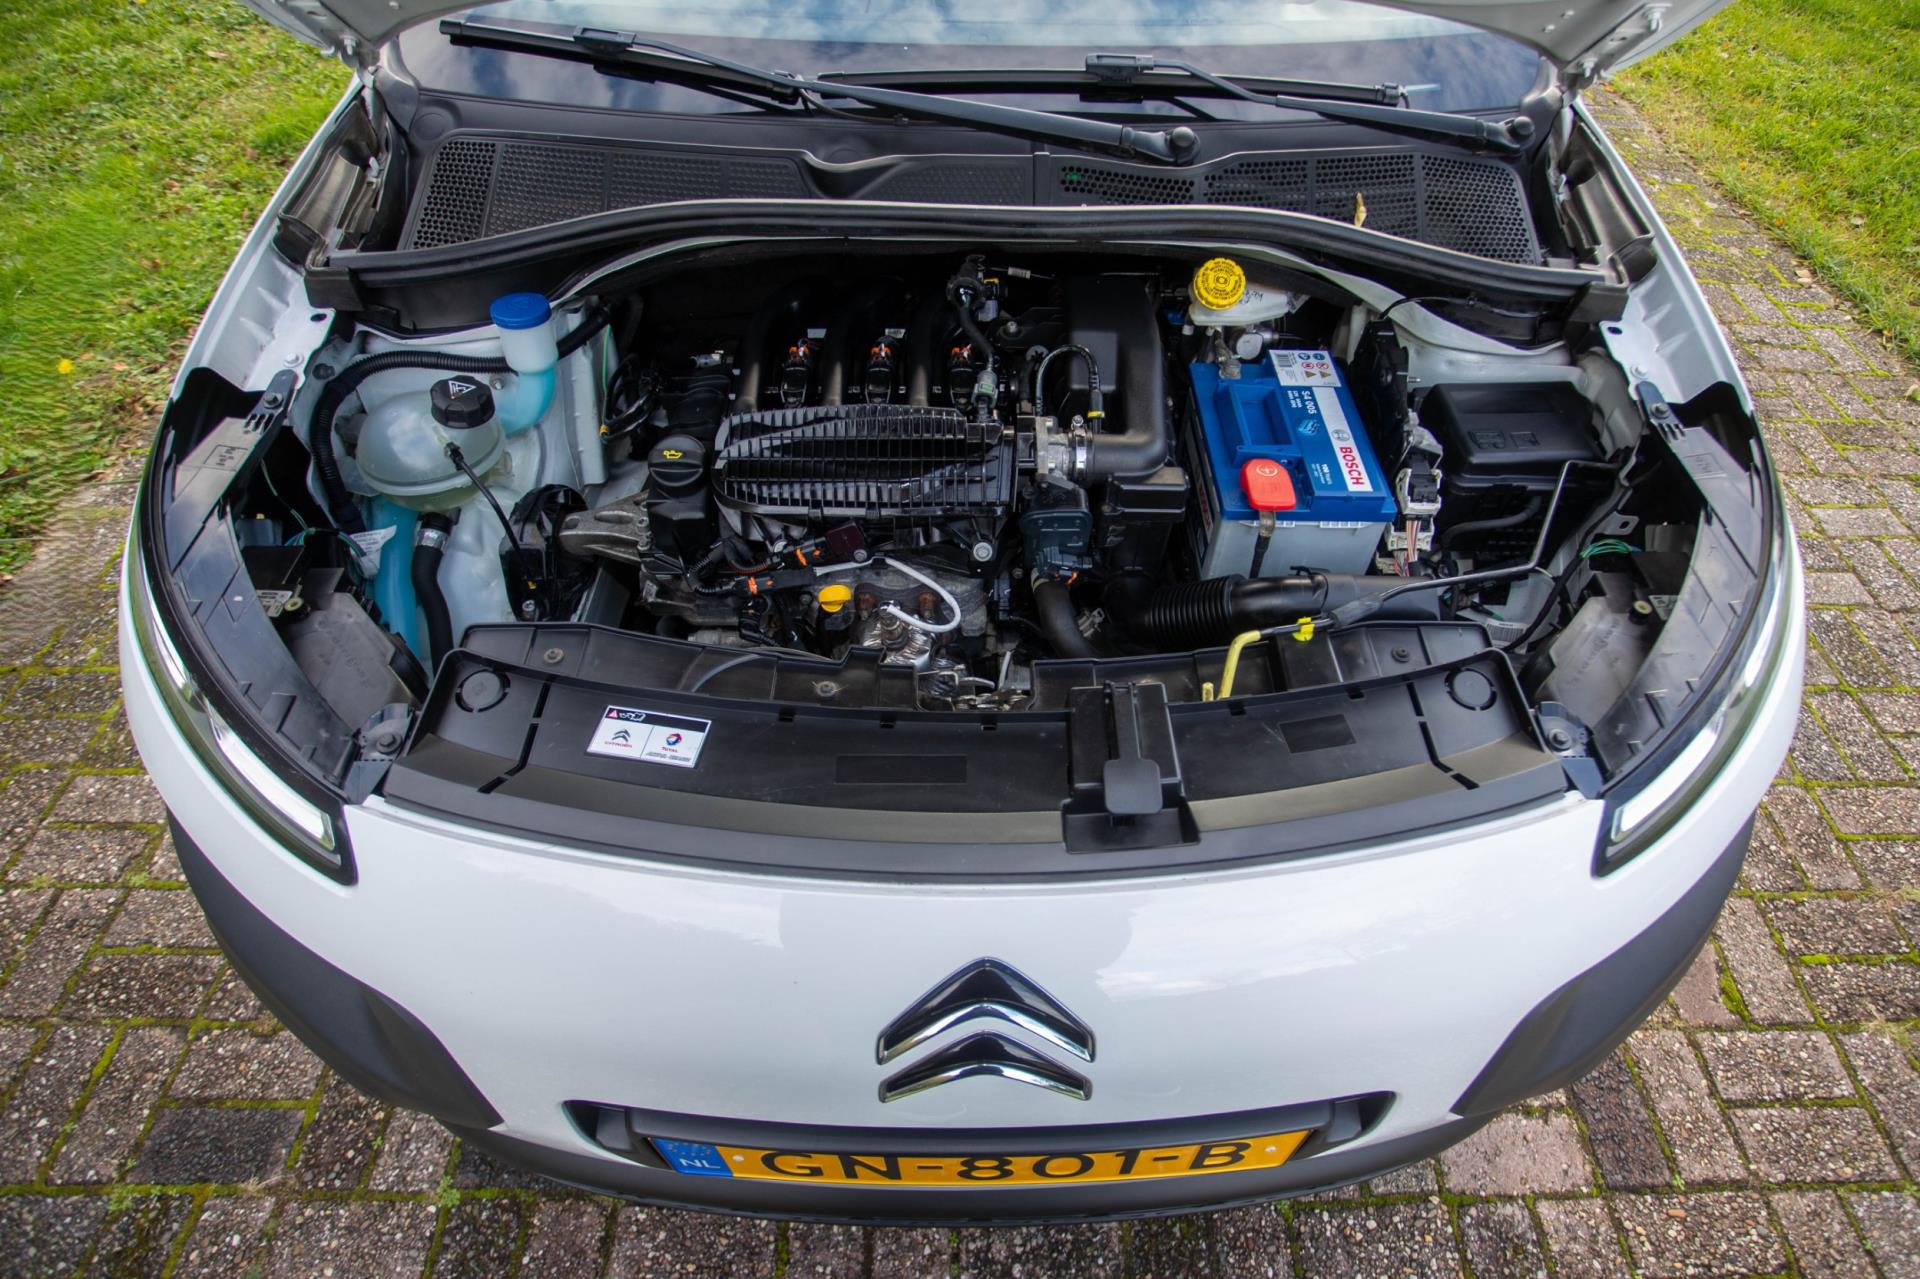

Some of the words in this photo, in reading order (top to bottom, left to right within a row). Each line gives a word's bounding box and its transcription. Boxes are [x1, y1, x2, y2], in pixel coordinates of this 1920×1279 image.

[1305, 400, 1317, 414] 005
[1339, 447, 1365, 485] BOSCH
[679, 1158, 721, 1169] NL
[761, 1141, 1253, 1181] GN-801-B
